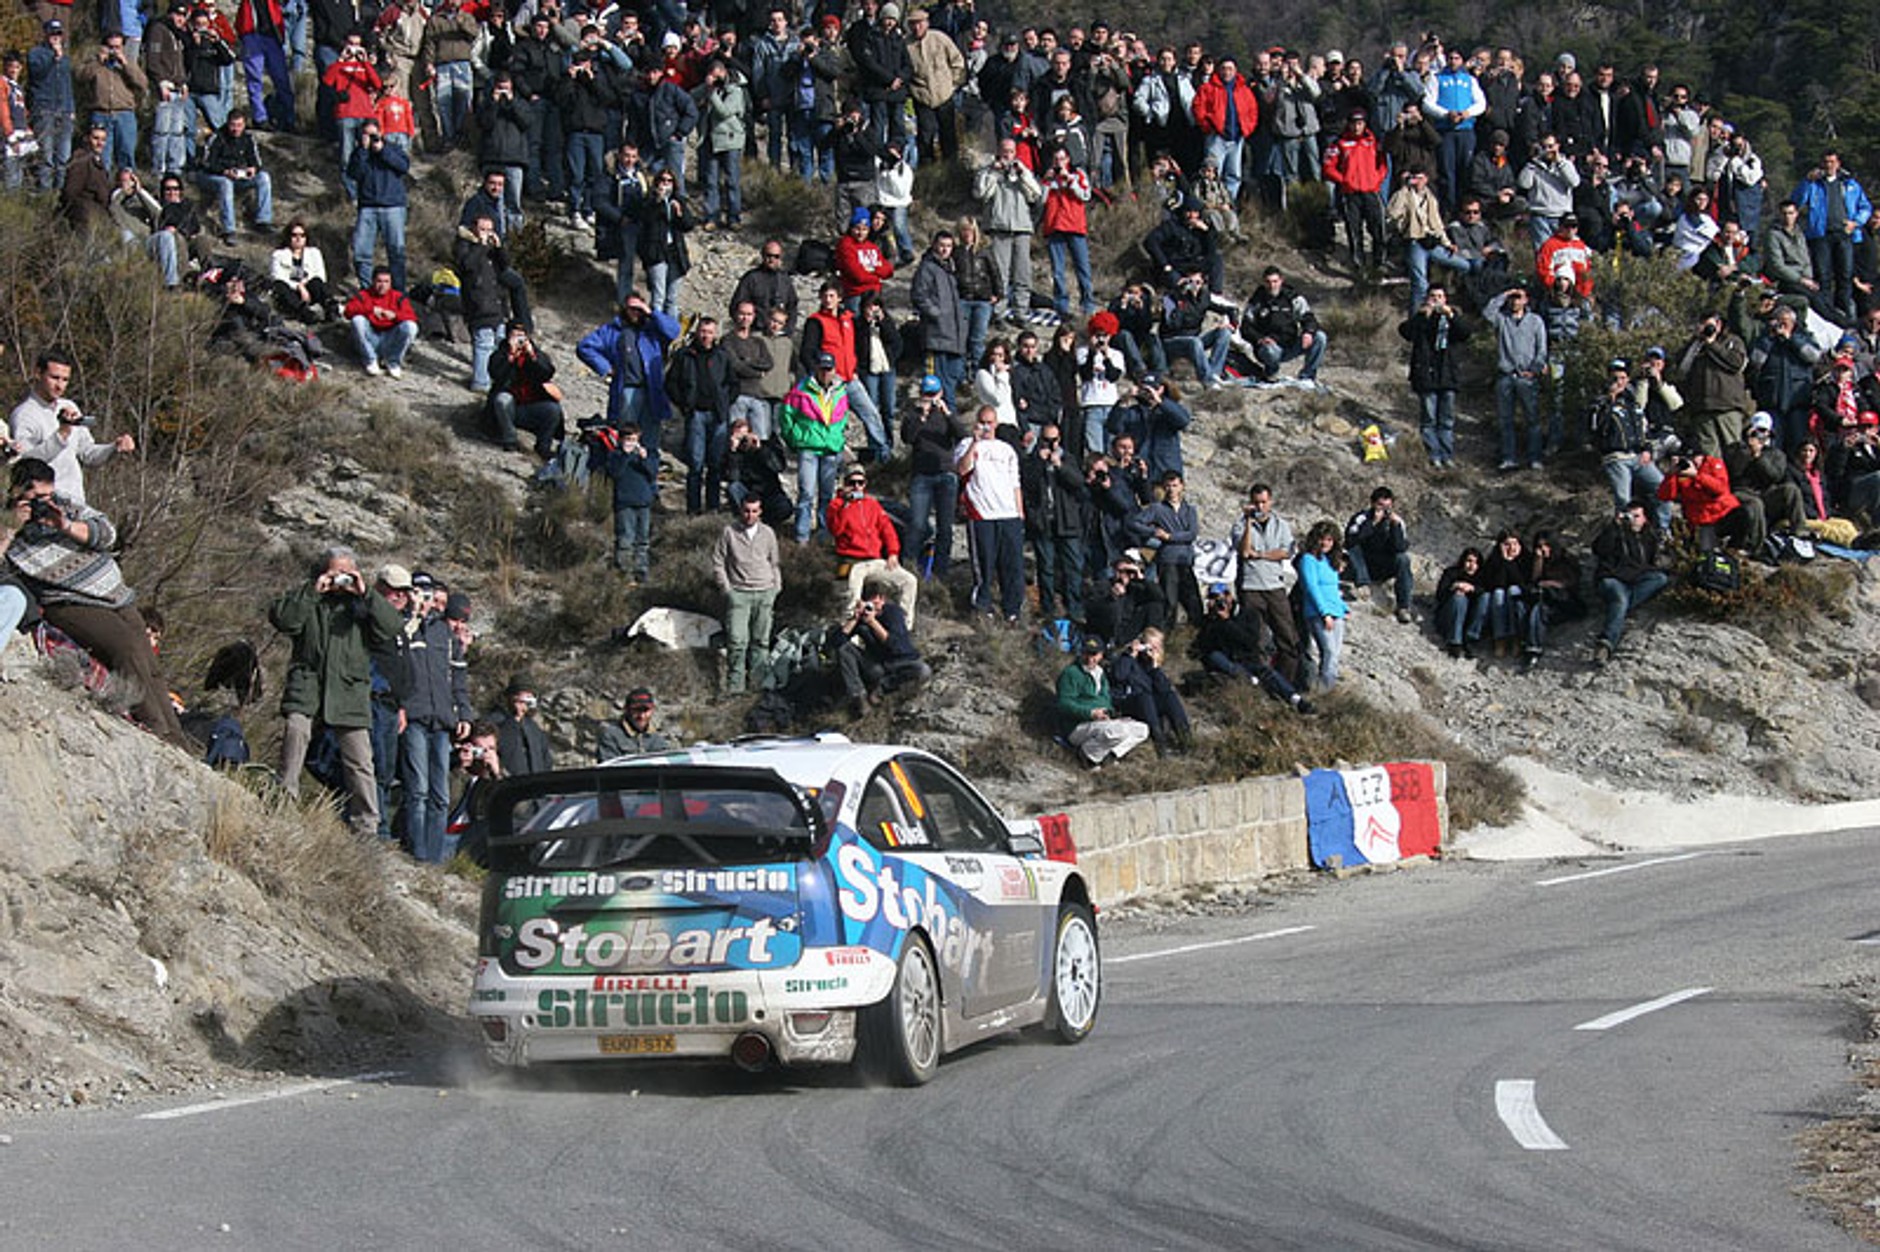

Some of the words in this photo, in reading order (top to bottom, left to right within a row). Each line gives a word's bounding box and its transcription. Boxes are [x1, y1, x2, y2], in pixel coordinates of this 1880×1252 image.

[505, 873, 616, 899] Structo
[662, 868, 789, 892] Structo
[837, 842, 995, 985] Stobart
[514, 916, 777, 969] Stobart
[593, 974, 691, 991] PIRELLI
[536, 985, 748, 1028] Structo
[643, 1034, 675, 1052] STX
